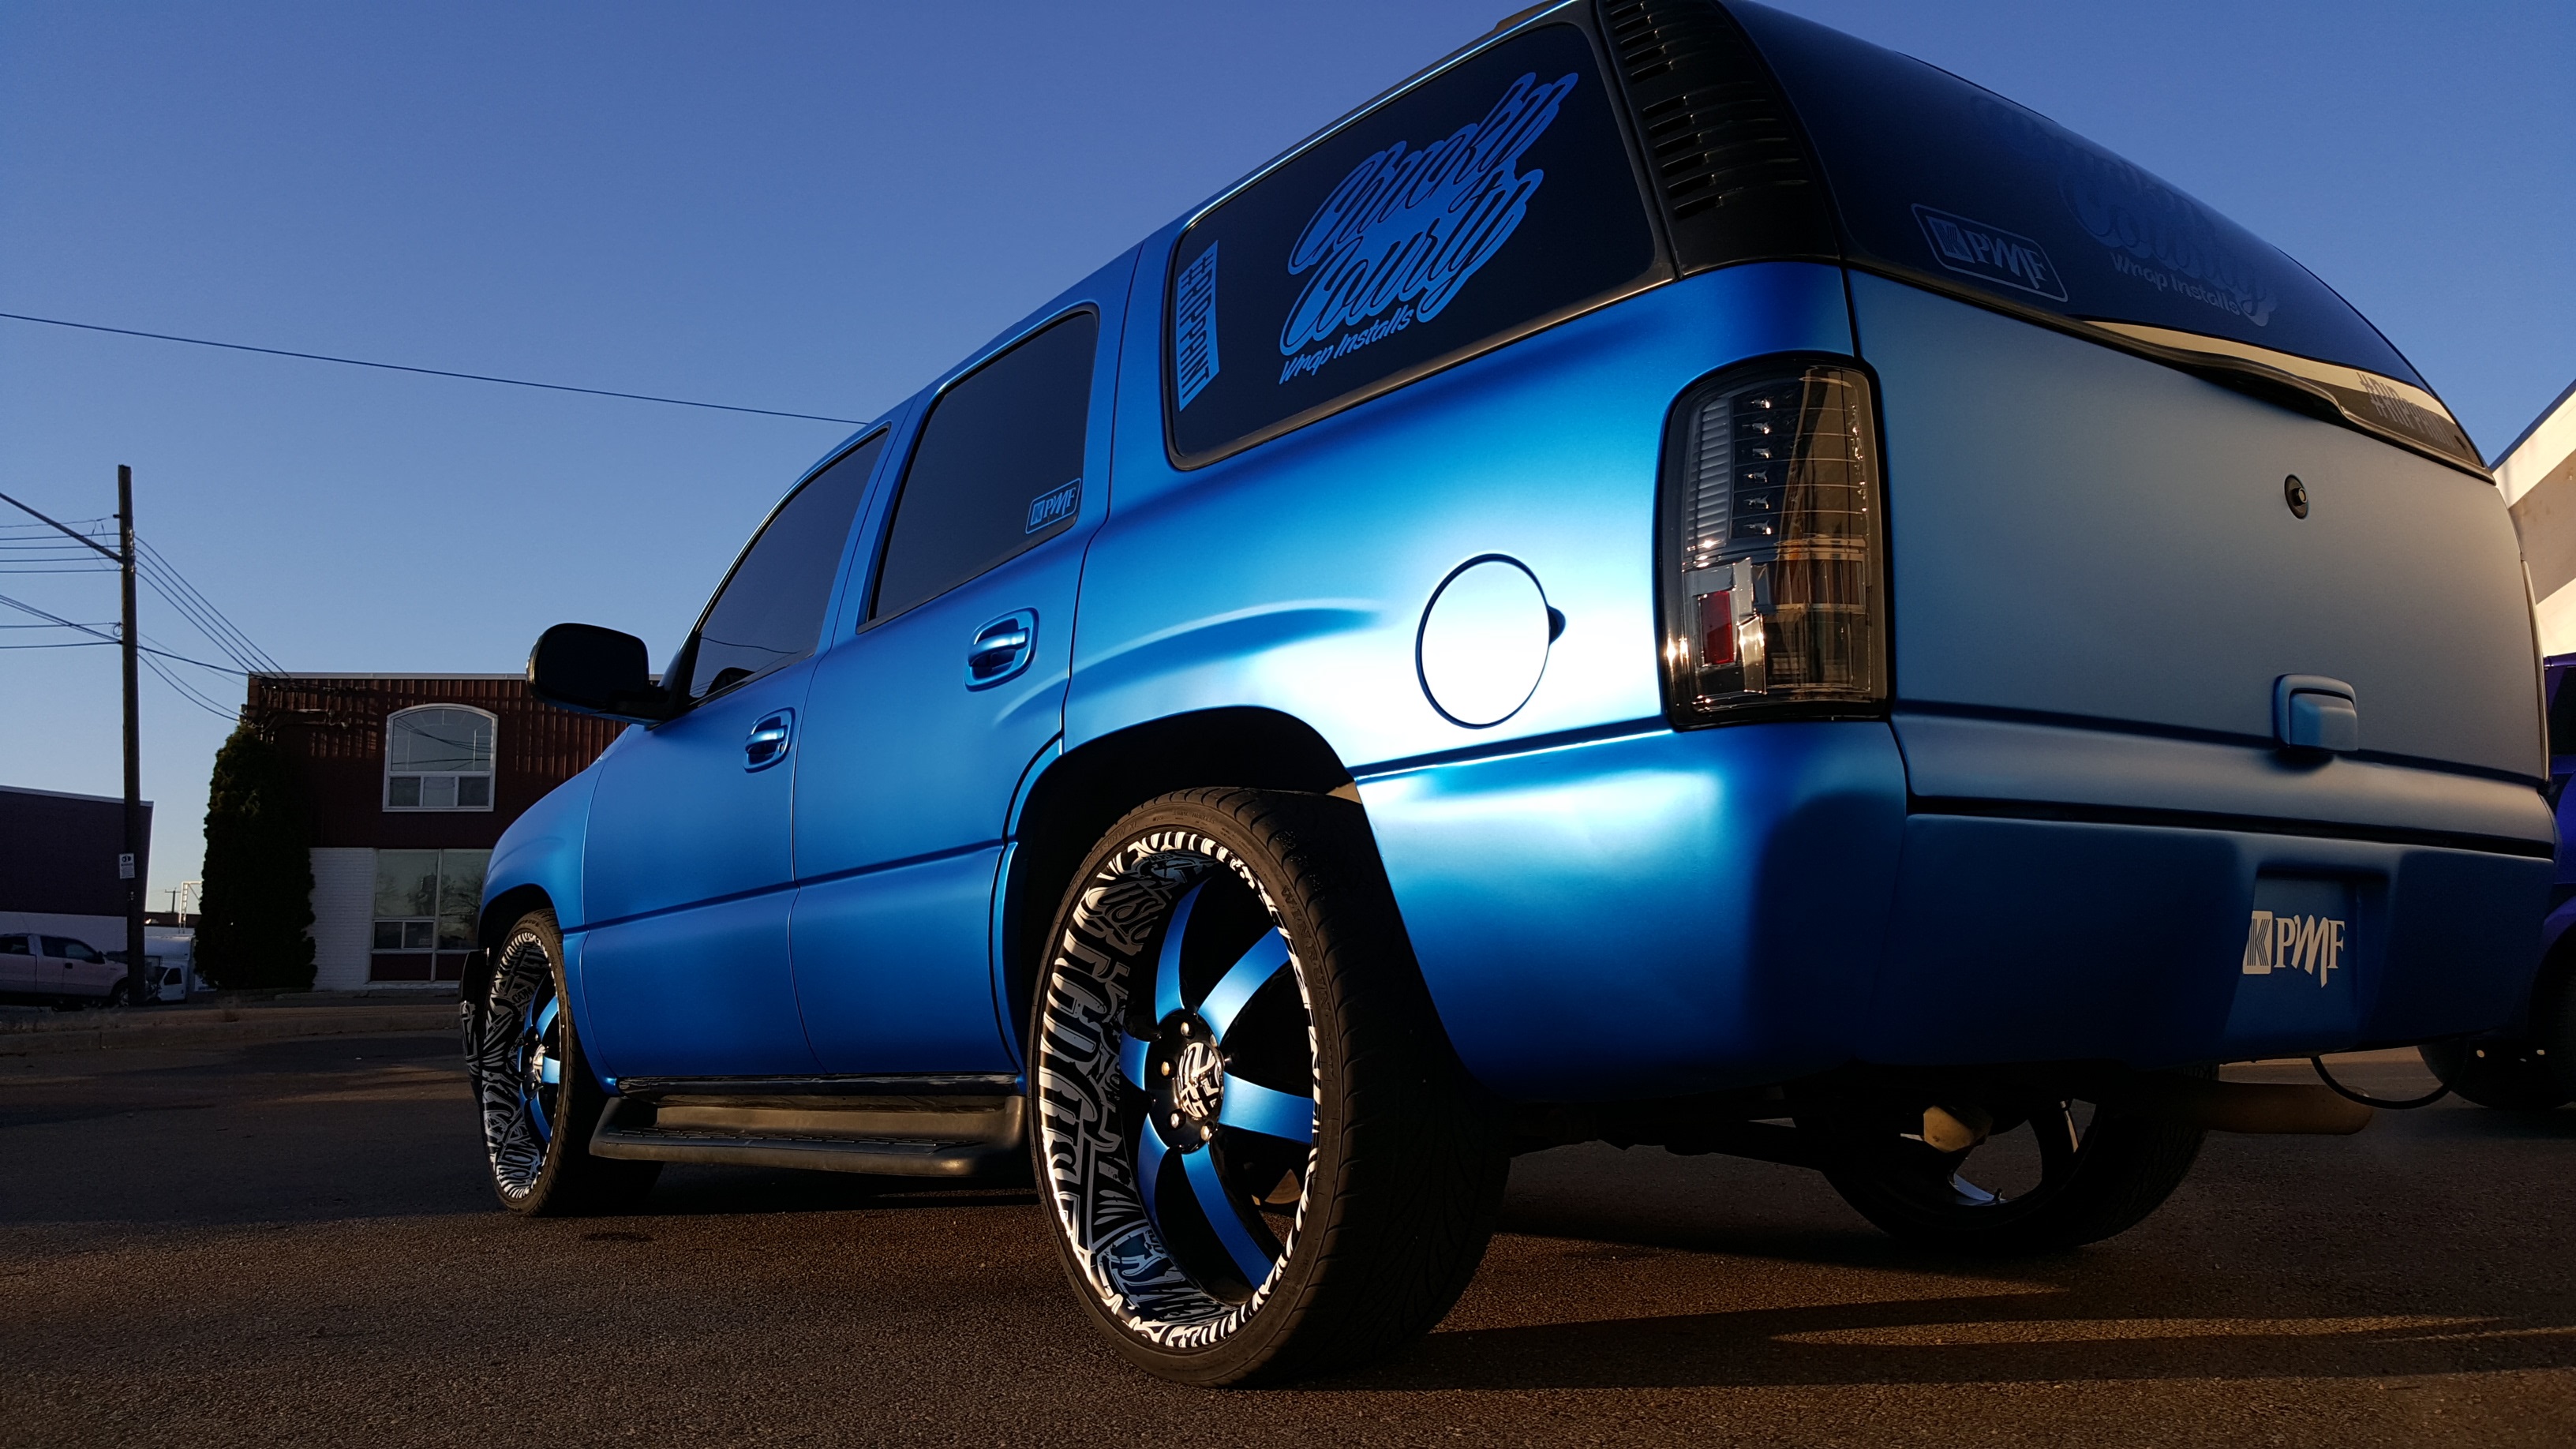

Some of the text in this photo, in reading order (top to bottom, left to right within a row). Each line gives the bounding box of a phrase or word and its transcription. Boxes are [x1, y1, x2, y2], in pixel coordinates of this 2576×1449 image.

[1926, 215, 2048, 290] KPMF
[2110, 253, 2241, 315] Wrap Installs
[1179, 252, 1215, 399] #RIPPAINT
[1279, 304, 1415, 385] Wrap Installs
[1029, 487, 1076, 526] KPMF
[2242, 910, 2346, 988] KPMF
